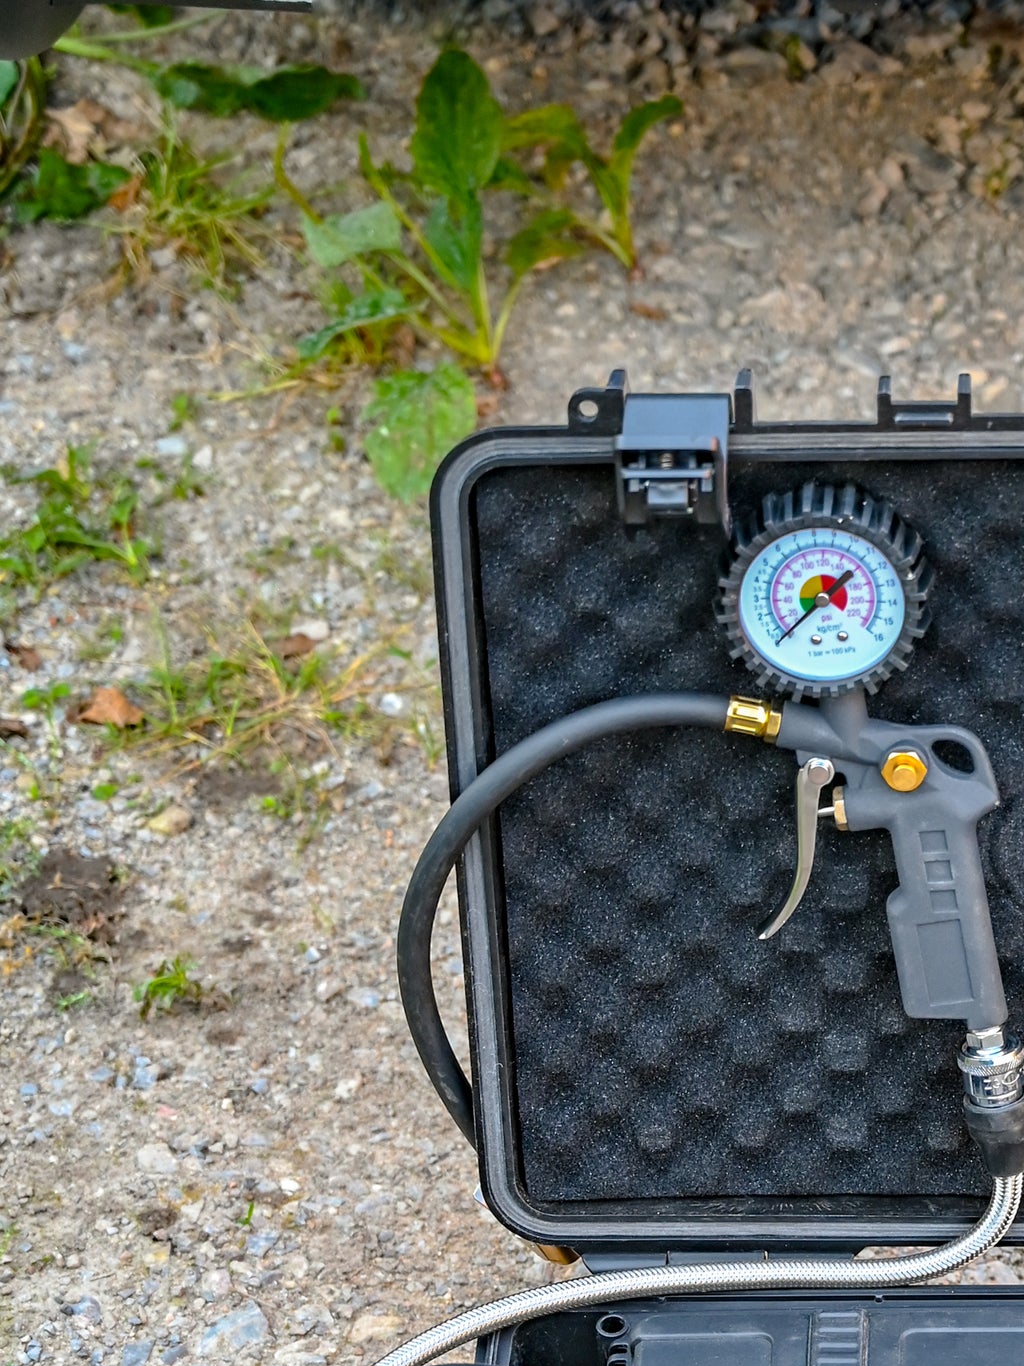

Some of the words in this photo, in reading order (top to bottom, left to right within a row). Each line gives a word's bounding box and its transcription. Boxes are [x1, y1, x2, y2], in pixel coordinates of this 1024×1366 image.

[849, 535, 859, 544] 10
[775, 544, 781, 552] 6
[762, 558, 768, 566] 5
[801, 561, 815, 570] 100
[816, 558, 830, 567] 120
[878, 562, 888, 570] 12
[792, 570, 802, 579] 80
[784, 582, 794, 590] 60
[849, 582, 862, 590] 180
[754, 594, 760, 603] 3
[850, 596, 864, 604] 200
[788, 608, 798, 616] 20
[847, 609, 862, 617] 220
[757, 613, 763, 621] 2
[820, 613, 832, 622] psi
[884, 617, 894, 625] 15
[874, 634, 884, 642] 16
